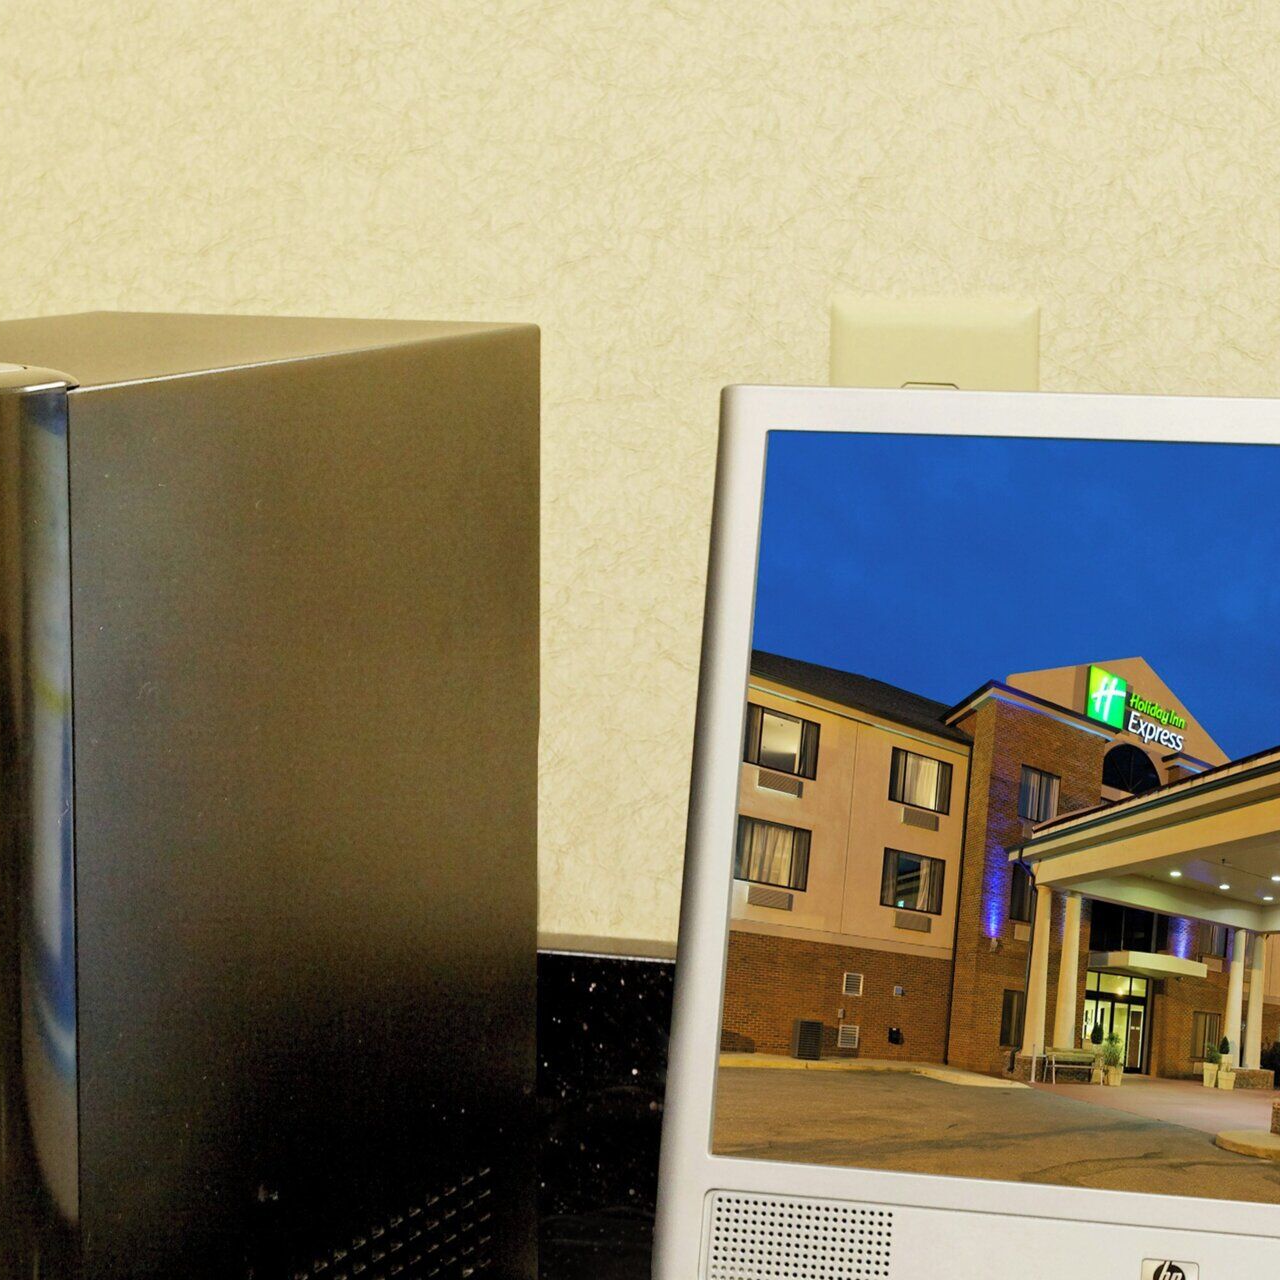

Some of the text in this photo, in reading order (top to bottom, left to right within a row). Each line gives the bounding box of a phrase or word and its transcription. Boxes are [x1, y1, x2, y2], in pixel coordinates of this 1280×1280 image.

[1130, 692, 1186, 729] Holiday Inn
[1128, 710, 1185, 751] Express
